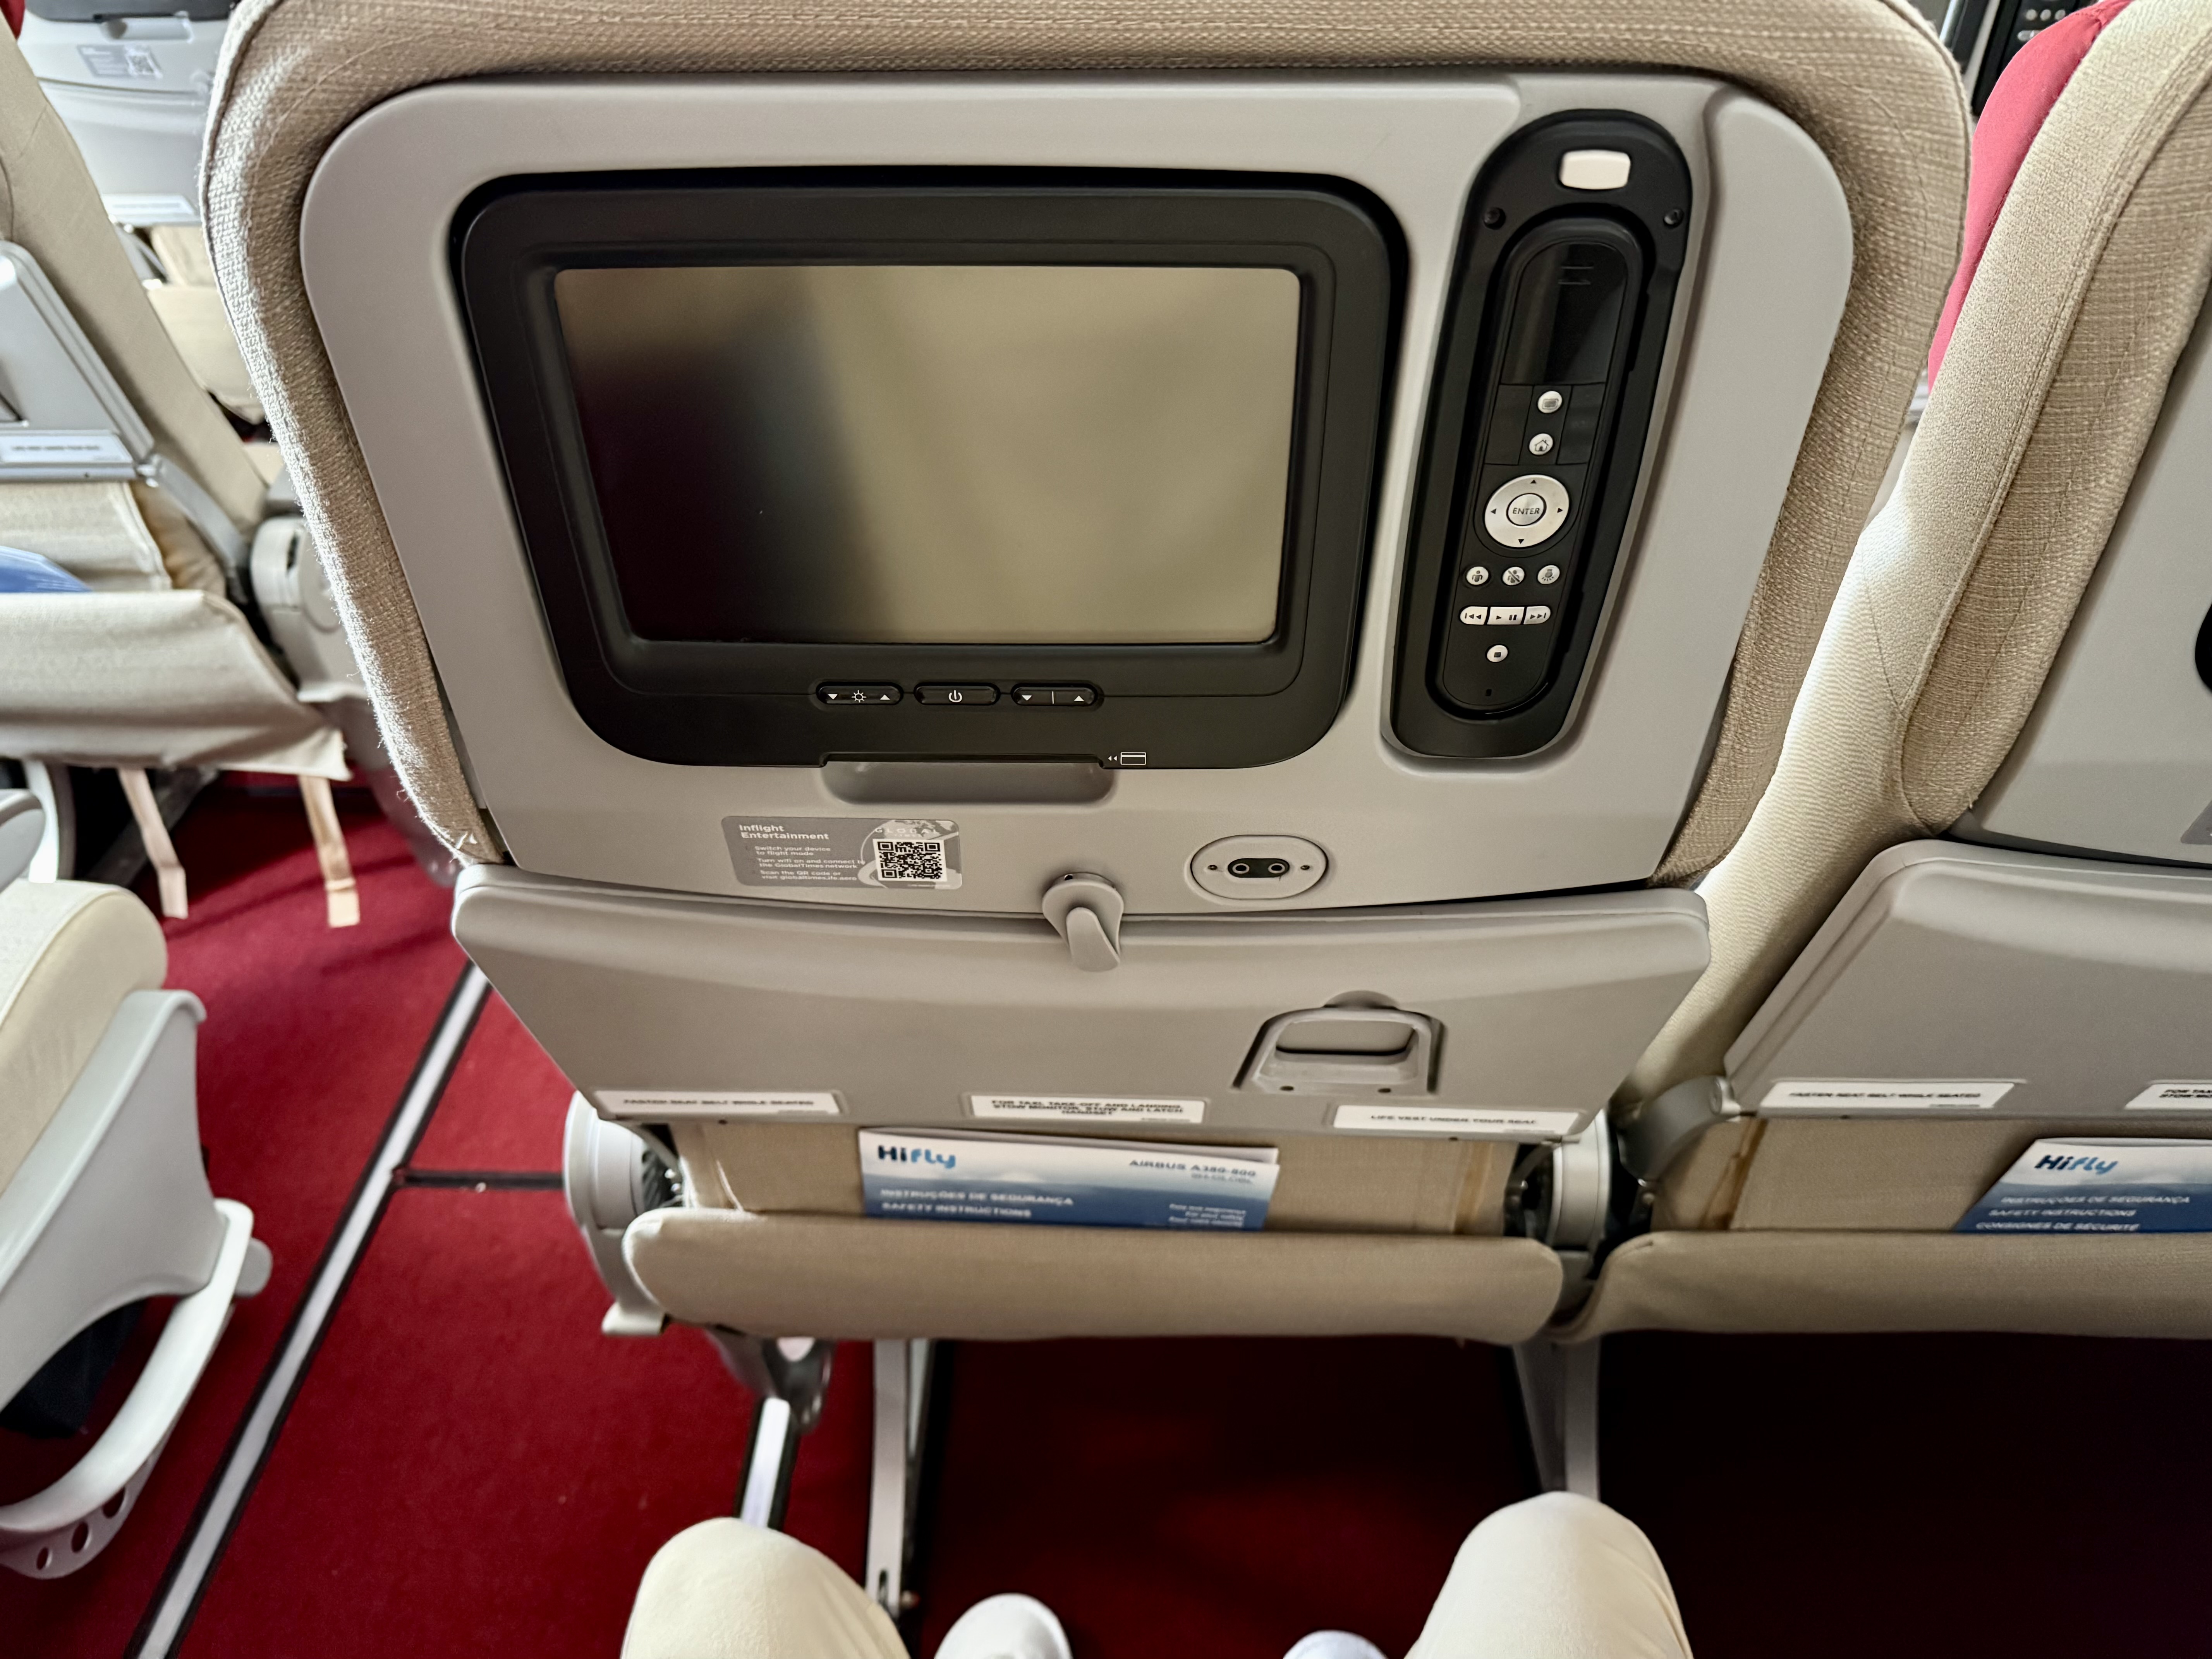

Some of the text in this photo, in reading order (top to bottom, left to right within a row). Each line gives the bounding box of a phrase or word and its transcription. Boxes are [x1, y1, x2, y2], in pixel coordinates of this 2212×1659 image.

[878, 1145, 956, 1169] Hifly
[2034, 1154, 2118, 1175] Hifly
[1129, 1160, 1186, 1171] AIRBUS
[969, 1192, 987, 1200] DE
[882, 1202, 1031, 1218] SAFETY INSTRUCTIONS
